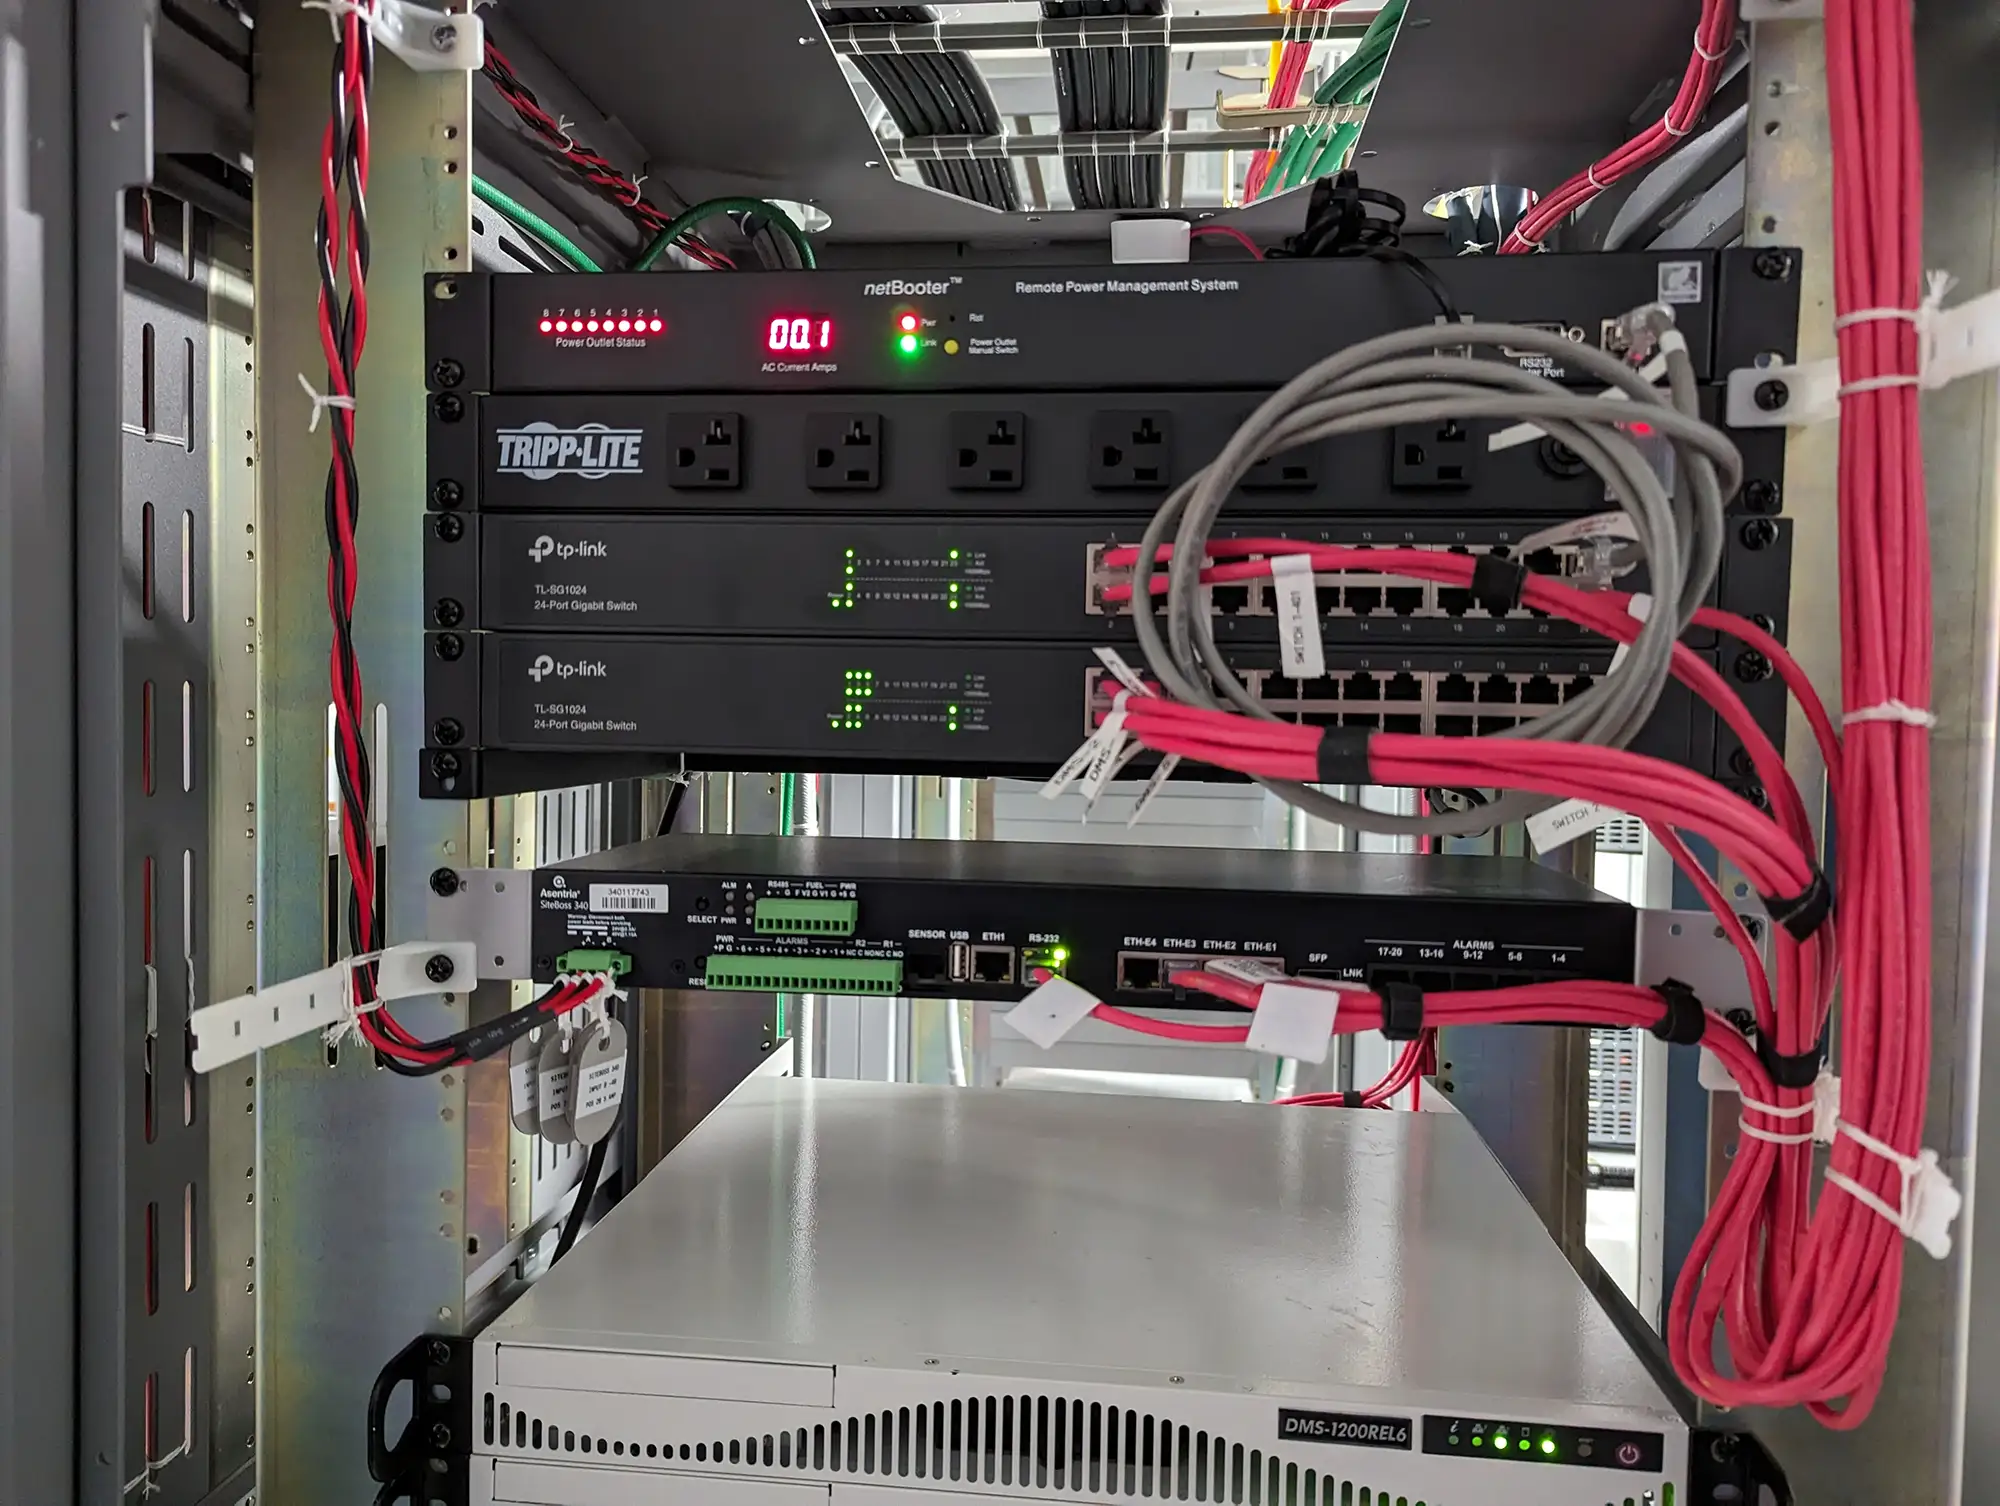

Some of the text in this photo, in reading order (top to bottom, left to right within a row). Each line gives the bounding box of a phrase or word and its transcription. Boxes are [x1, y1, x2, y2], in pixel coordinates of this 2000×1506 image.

[1015, 279, 1238, 294] Remote Power Management System
[543, 308, 658, 318] 8 7 6 5 4 3 2 1
[555, 337, 646, 348] Power Outlet Status
[970, 338, 1017, 346] Power Outlet
[995, 346, 1019, 354] Switch
[761, 363, 837, 373] AC Current Amps
[1519, 358, 1553, 368] RS232
[1543, 368, 1564, 378] Port
[534, 584, 587, 595] TL-SG1024
[534, 600, 638, 612] 24-Port Gigabit Switch
[534, 703, 587, 714] TL-SG1024
[534, 719, 637, 732] 24-Port Gigabit Switch
[1551, 806, 1589, 830] SWITCH
[721, 882, 737, 890] ALM
[746, 882, 752, 890] A
[767, 880, 856, 891] RS485 FUEL PWR
[608, 888, 650, 897] 340117743
[802, 889, 811, 897] V2
[540, 900, 588, 911] SiteBoss 340
[687, 915, 737, 925] SELECT PWR
[908, 929, 946, 939] SENSOR
[950, 931, 969, 940] USB
[982, 932, 1005, 941] ETH1
[1028, 933, 1059, 943] RS-232
[716, 934, 894, 948] PWR ALARMS R2 R1
[1123, 936, 1157, 947] ETH-E4
[1163, 938, 1197, 948] ETH-E3
[1203, 940, 1236, 950] ETH-E2
[1452, 940, 1495, 951] ALARMS
[1243, 941, 1277, 952] ETH-E1
[893, 950, 904, 958] NO
[1308, 953, 1328, 963] SFP
[1378, 946, 1402, 957] 17-20
[1419, 948, 1444, 959] 13-16
[1462, 949, 1483, 960] 9-12
[1551, 953, 1567, 963] 1-4
[1343, 968, 1364, 979] LNK
[1284, 1416, 1408, 1443] DMS-1200REL6
